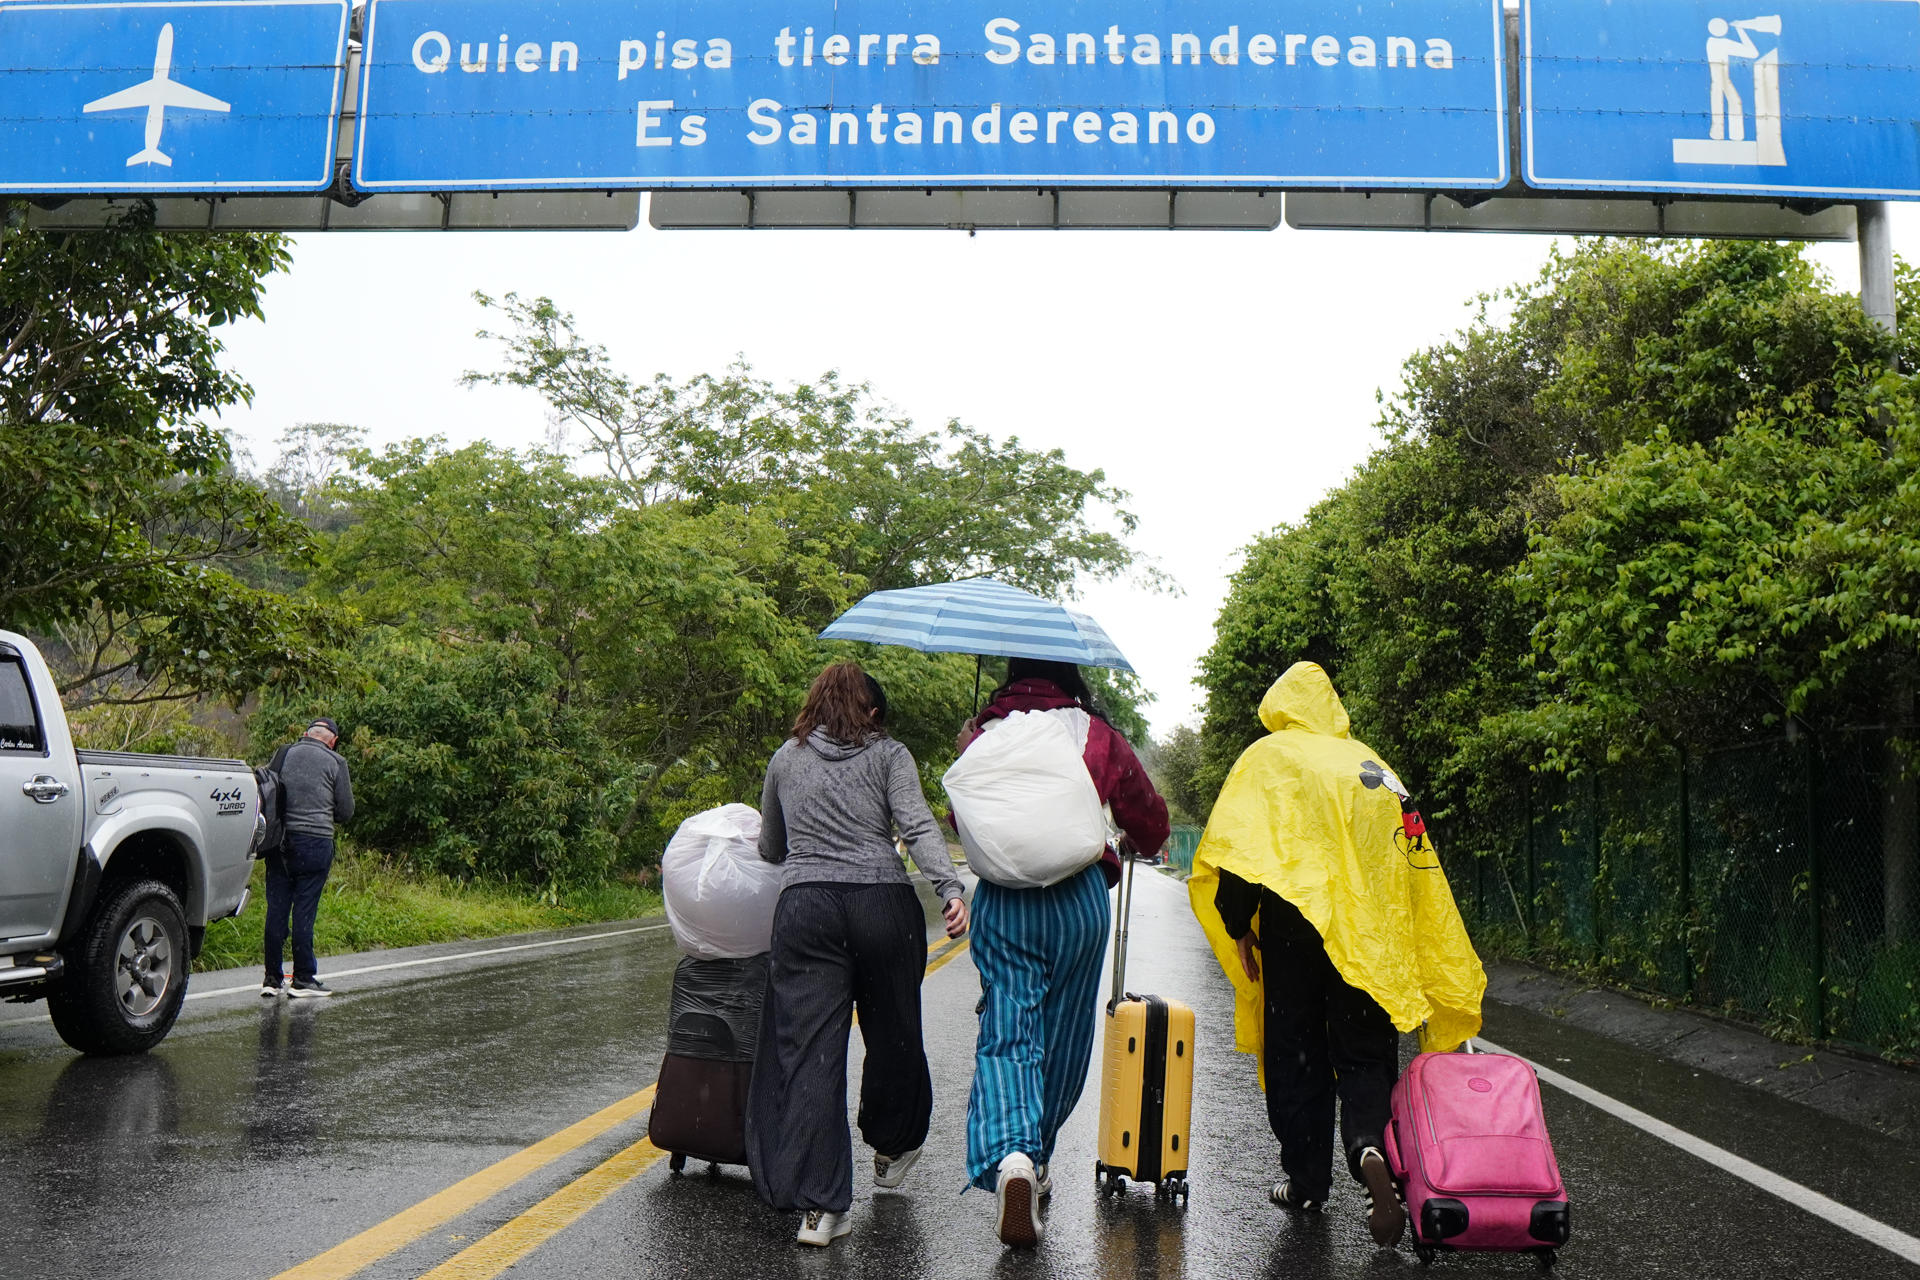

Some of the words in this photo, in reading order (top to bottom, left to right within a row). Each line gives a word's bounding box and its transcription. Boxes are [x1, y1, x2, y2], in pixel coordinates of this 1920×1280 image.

[411, 30, 579, 74] Quien
[617, 30, 733, 81] pisa
[774, 26, 941, 67] tierra
[984, 17, 1455, 70] Santandereana
[636, 100, 707, 147] Es
[746, 98, 1216, 146] Santandereano
[210, 787, 242, 801] 4x4
[219, 802, 246, 810] TURBO
